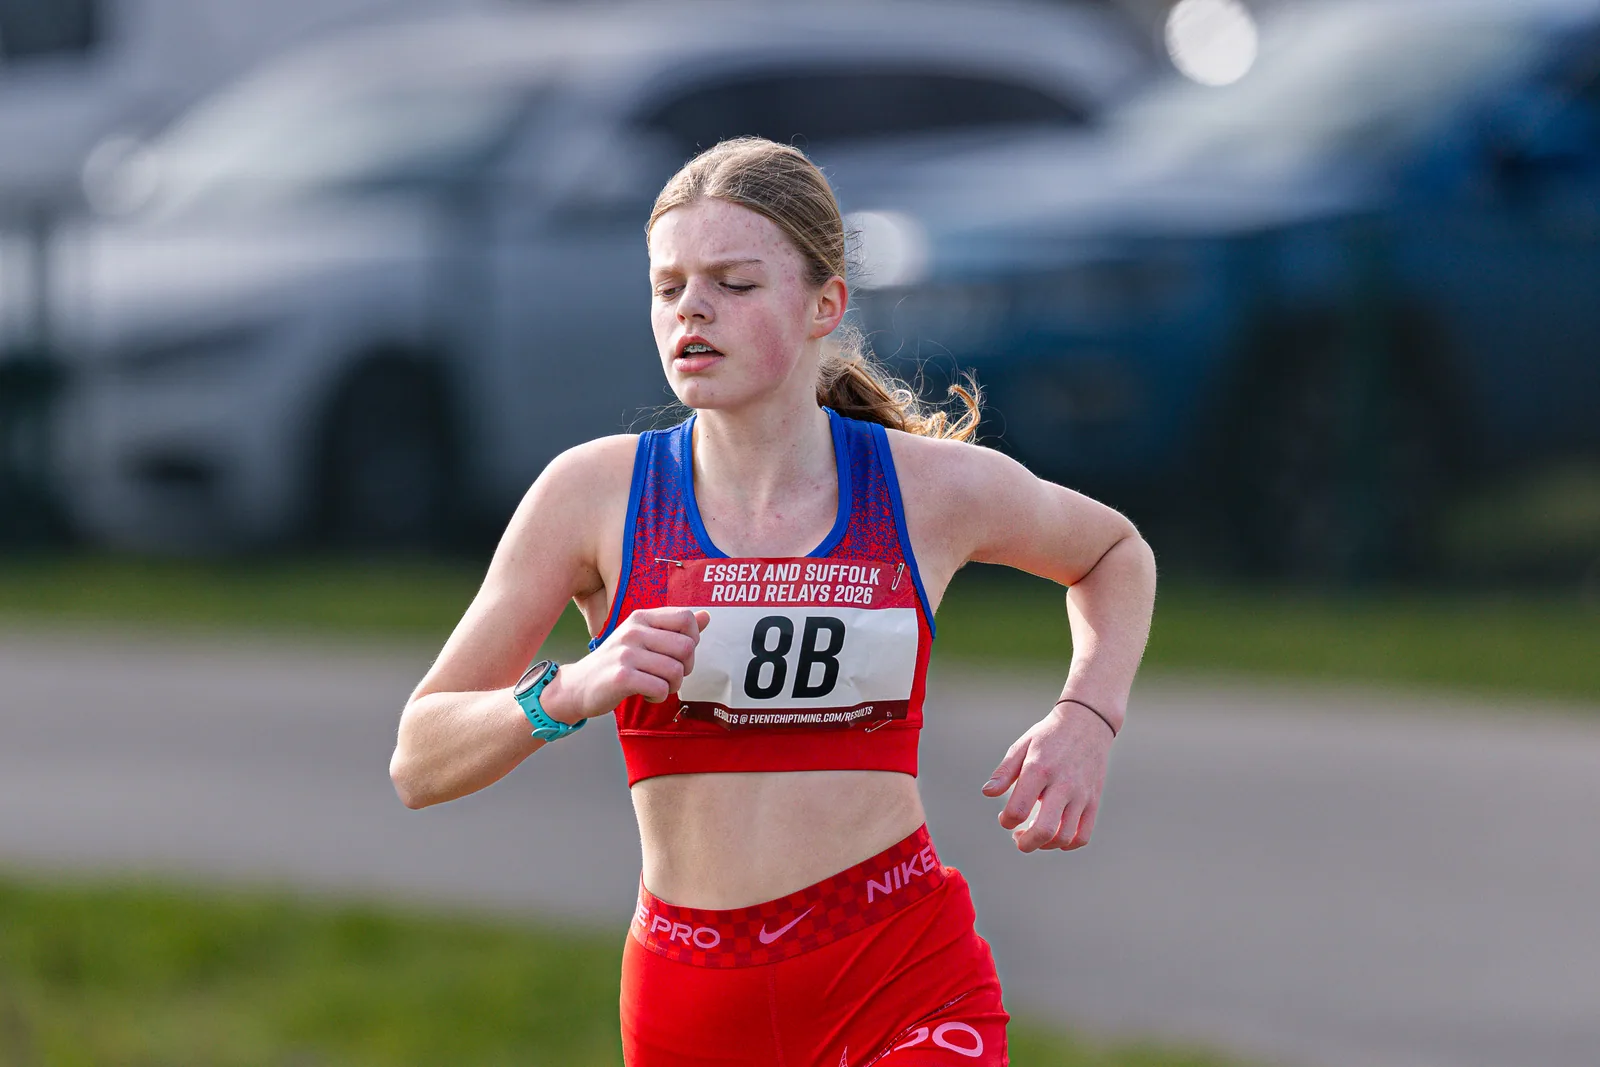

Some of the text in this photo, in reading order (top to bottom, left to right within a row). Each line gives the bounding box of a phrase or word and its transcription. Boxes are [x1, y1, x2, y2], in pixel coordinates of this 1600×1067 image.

[703, 563, 881, 586] ESSEX AND SUFFOLK
[711, 584, 873, 605] ROAD RELAYS 2026
[744, 615, 846, 700] 8B
[713, 705, 874, 725] RESULTS @ EVENTCHIPTIMING.COM/RESULTS
[867, 845, 936, 904] NIKE
[650, 914, 721, 949] PRO
